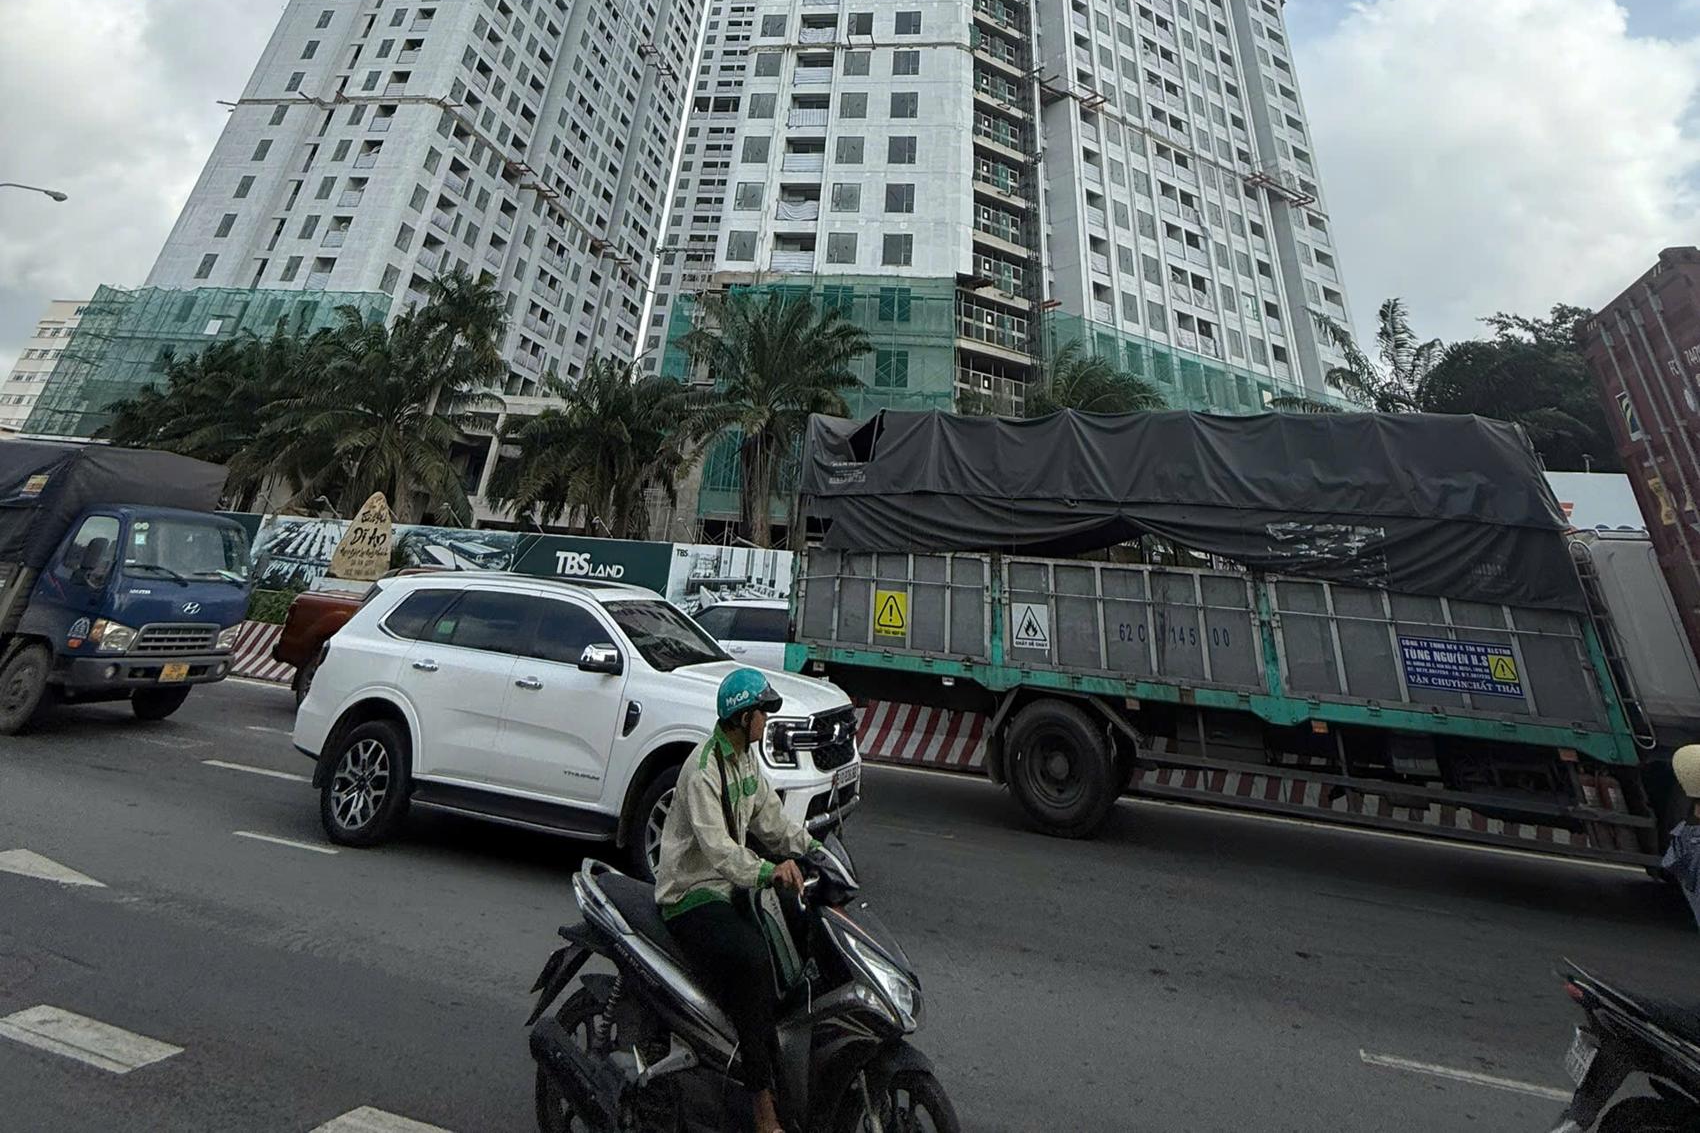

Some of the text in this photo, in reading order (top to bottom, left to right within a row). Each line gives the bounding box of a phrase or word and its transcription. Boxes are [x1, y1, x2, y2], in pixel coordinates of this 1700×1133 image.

[676, 549, 688, 557] TBS
[556, 551, 624, 578] TBS LAND
[1403, 646, 1431, 661] TÙNG
